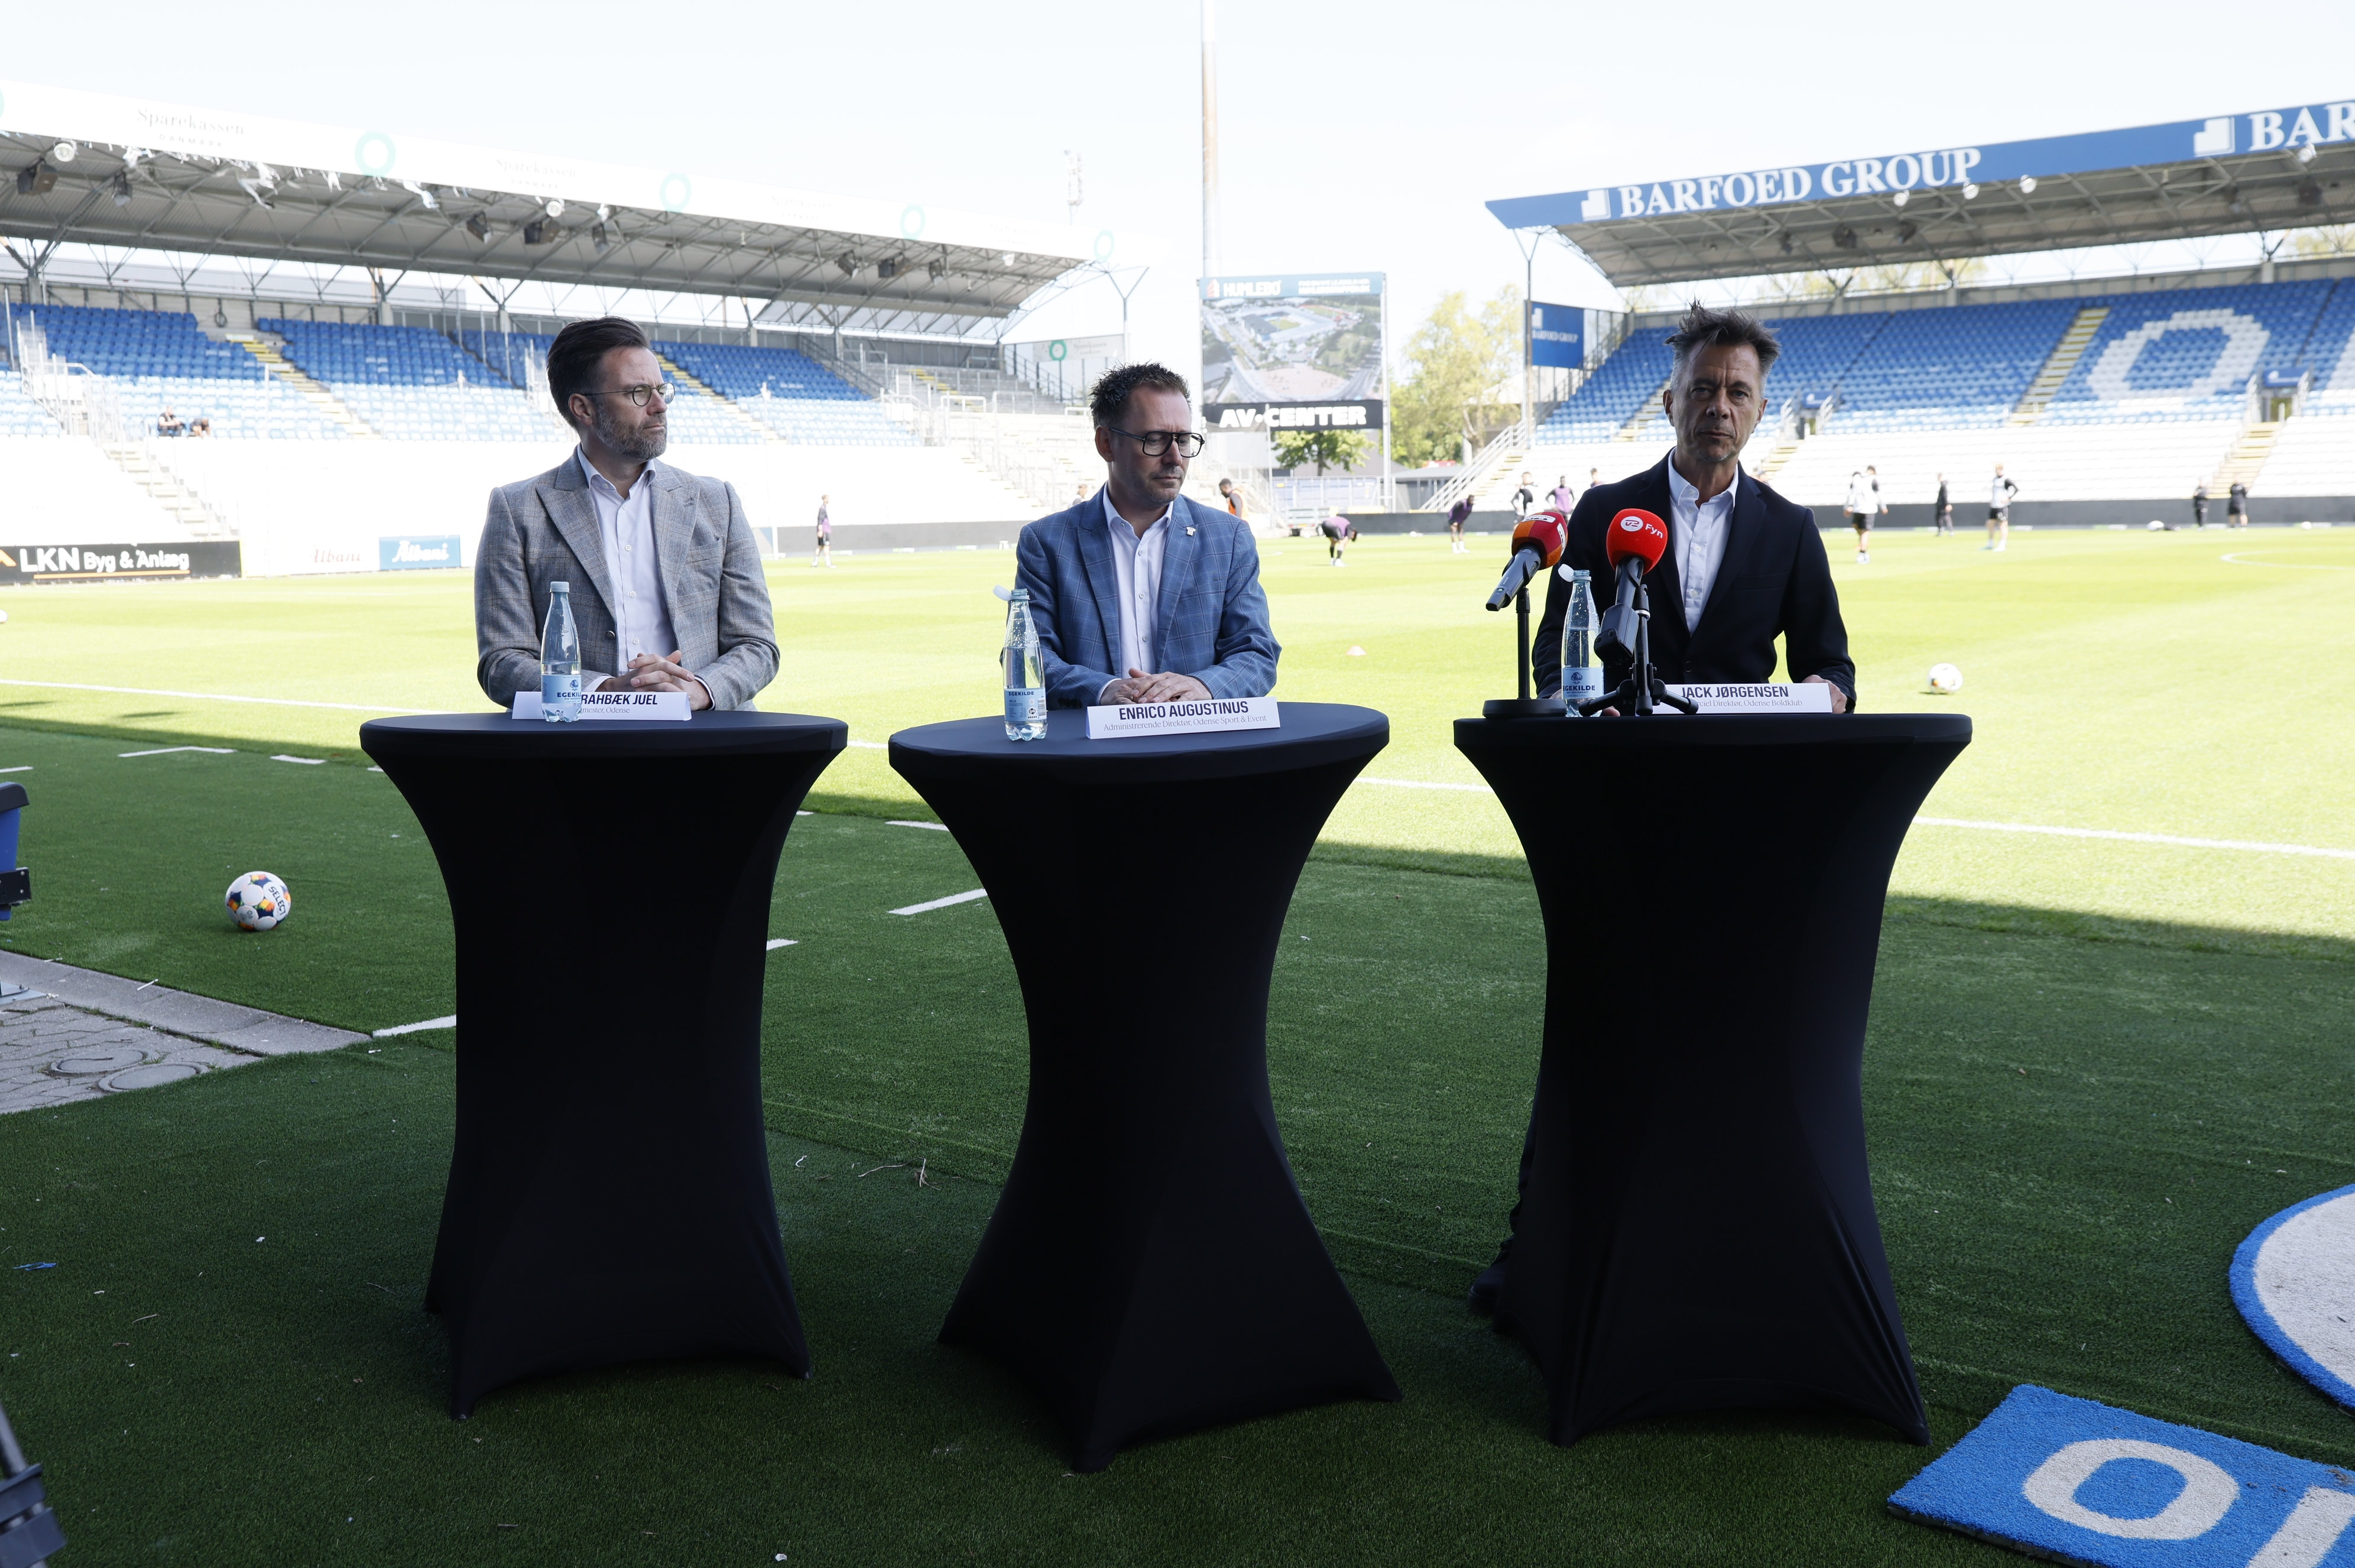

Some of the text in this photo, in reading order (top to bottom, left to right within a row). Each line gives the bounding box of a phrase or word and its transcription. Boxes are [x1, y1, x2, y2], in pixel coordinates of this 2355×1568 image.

[137, 108, 244, 135] Sparekassen
[1618, 147, 1981, 217] BARFOED GROUP
[1645, 523, 1663, 538] Fyn
[20, 547, 80, 572] LKN
[83, 551, 116, 573] Byg
[119, 551, 134, 569] &
[581, 694, 658, 705] RAHBÆK JUEL
[1682, 686, 1789, 698] JACK JØRGENSEN
[1119, 701, 1248, 720] ENRICO AUGUSTINUS
[1104, 720, 1162, 731] Administrerende
[1163, 718, 1192, 728] Direktør,
[1193, 717, 1219, 726] Odense
[1220, 716, 1239, 726] Sport
[268, 886, 286, 916] SELECT
